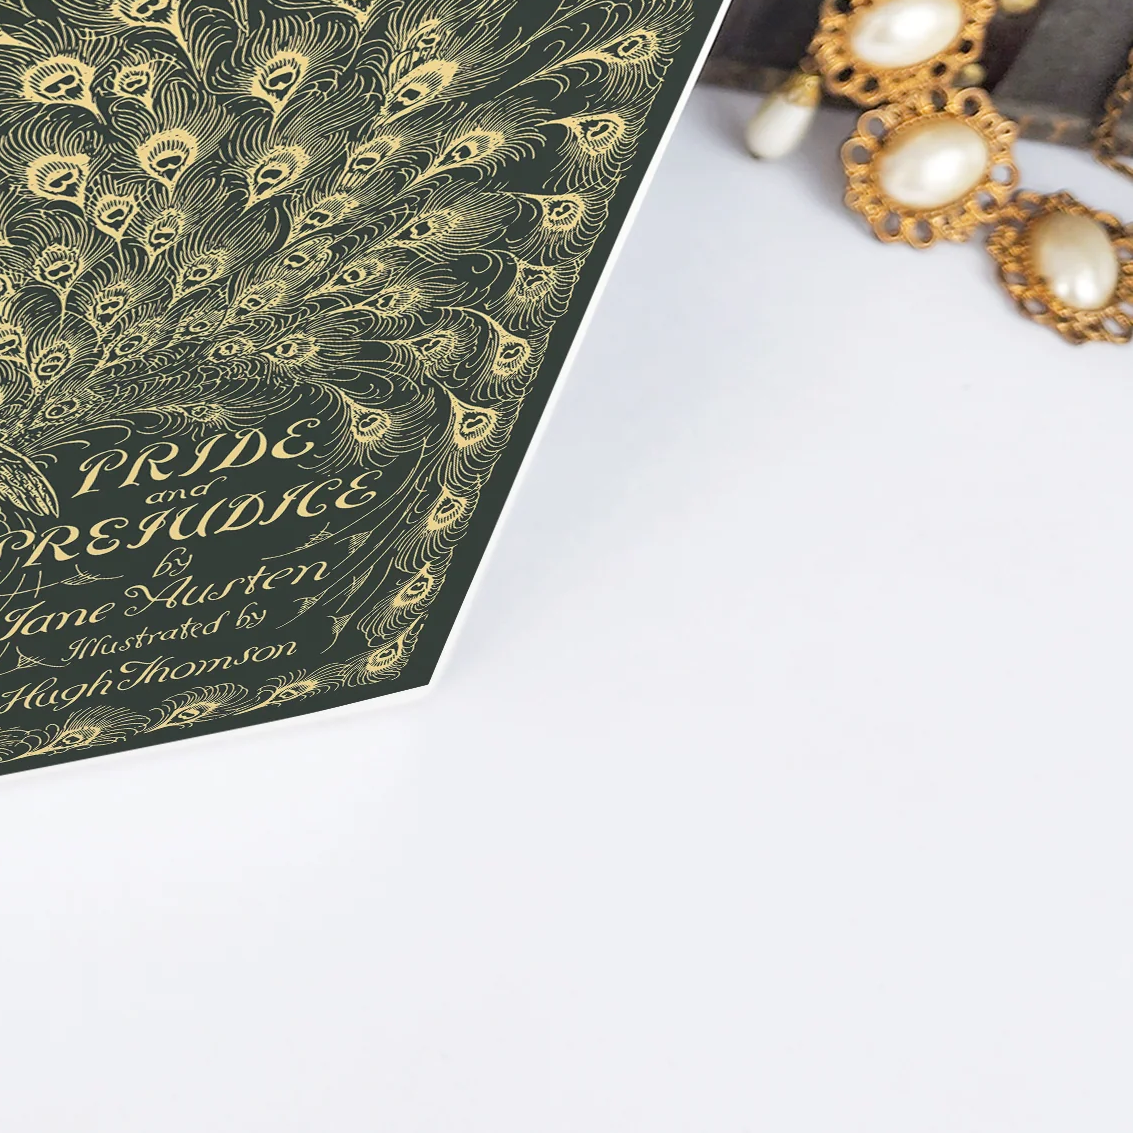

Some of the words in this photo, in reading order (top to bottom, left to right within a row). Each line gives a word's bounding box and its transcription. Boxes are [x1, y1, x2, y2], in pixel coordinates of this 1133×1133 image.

[70, 417, 321, 499] PRIDE
[144, 475, 228, 505] and
[123, 561, 331, 617] Austen
[151, 546, 194, 579] by
[60, 610, 231, 662] Illustrated
[234, 601, 267, 630] by
[116, 641, 298, 691] Thomson
